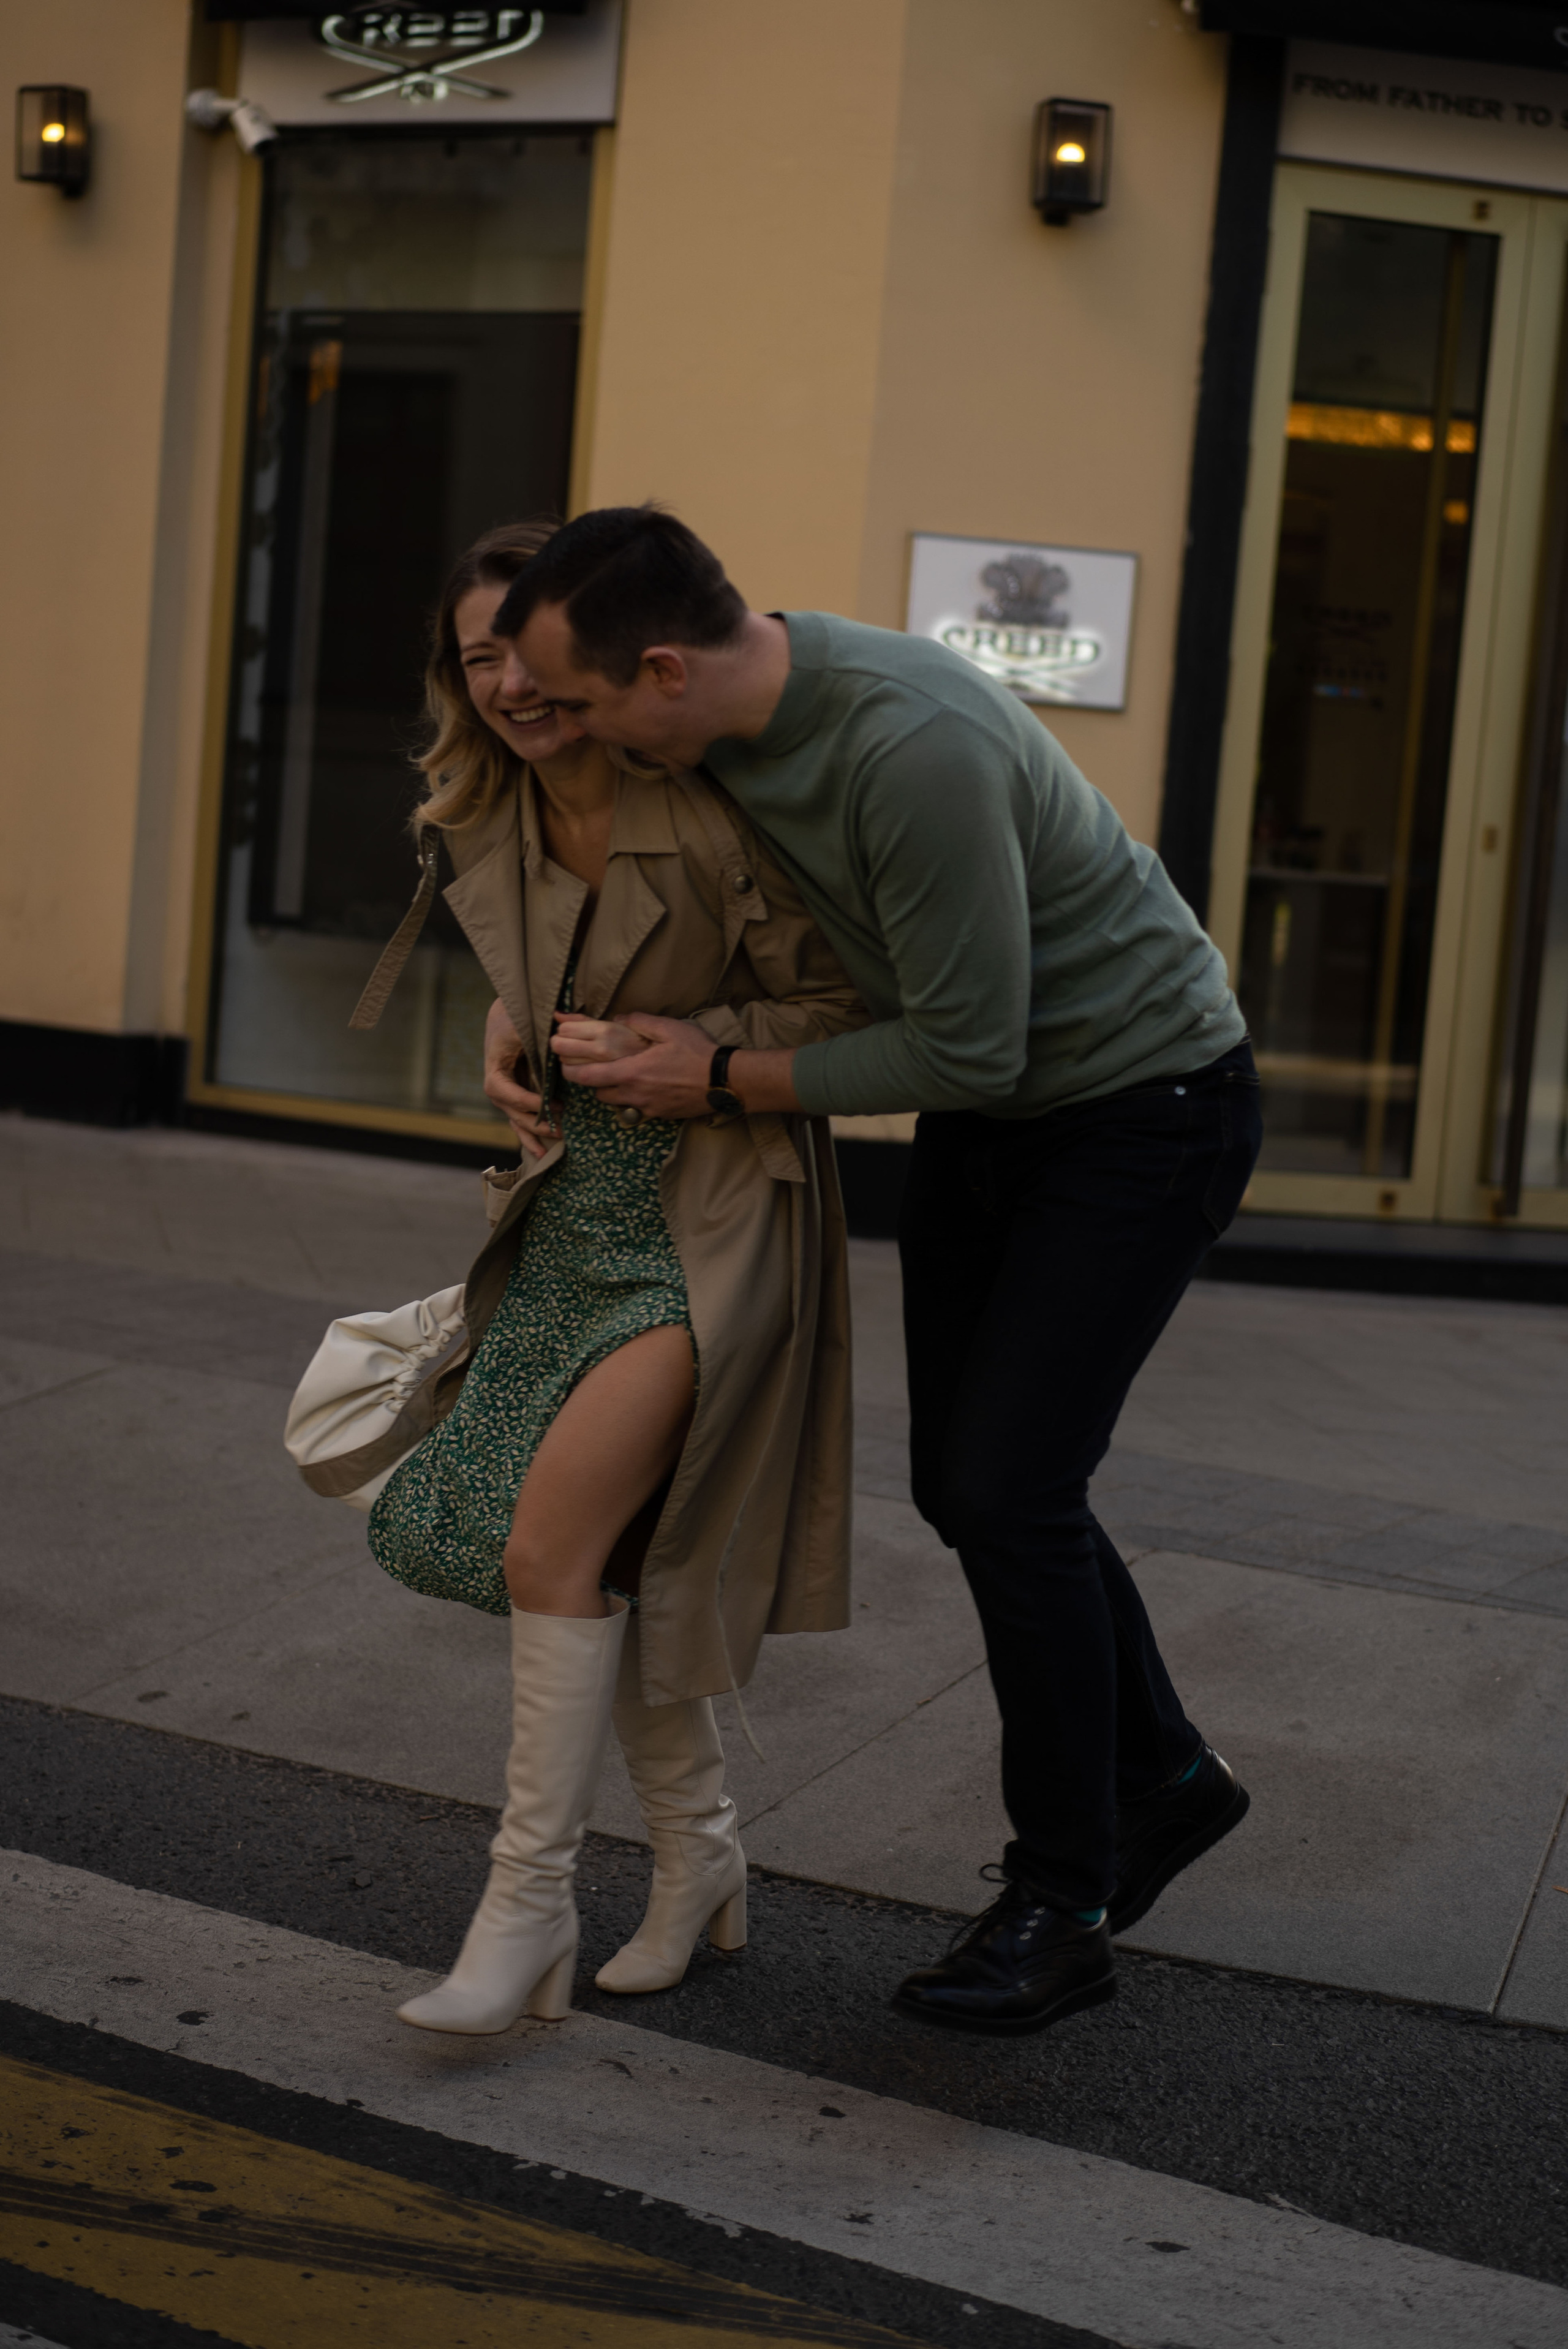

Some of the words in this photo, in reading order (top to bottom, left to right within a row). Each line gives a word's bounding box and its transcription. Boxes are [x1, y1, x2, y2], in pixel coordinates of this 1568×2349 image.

[1292, 73, 1379, 105] FROM
[1388, 86, 1504, 121] FATHER
[1513, 102, 1553, 127] TO
[943, 626, 1100, 669] CREED
